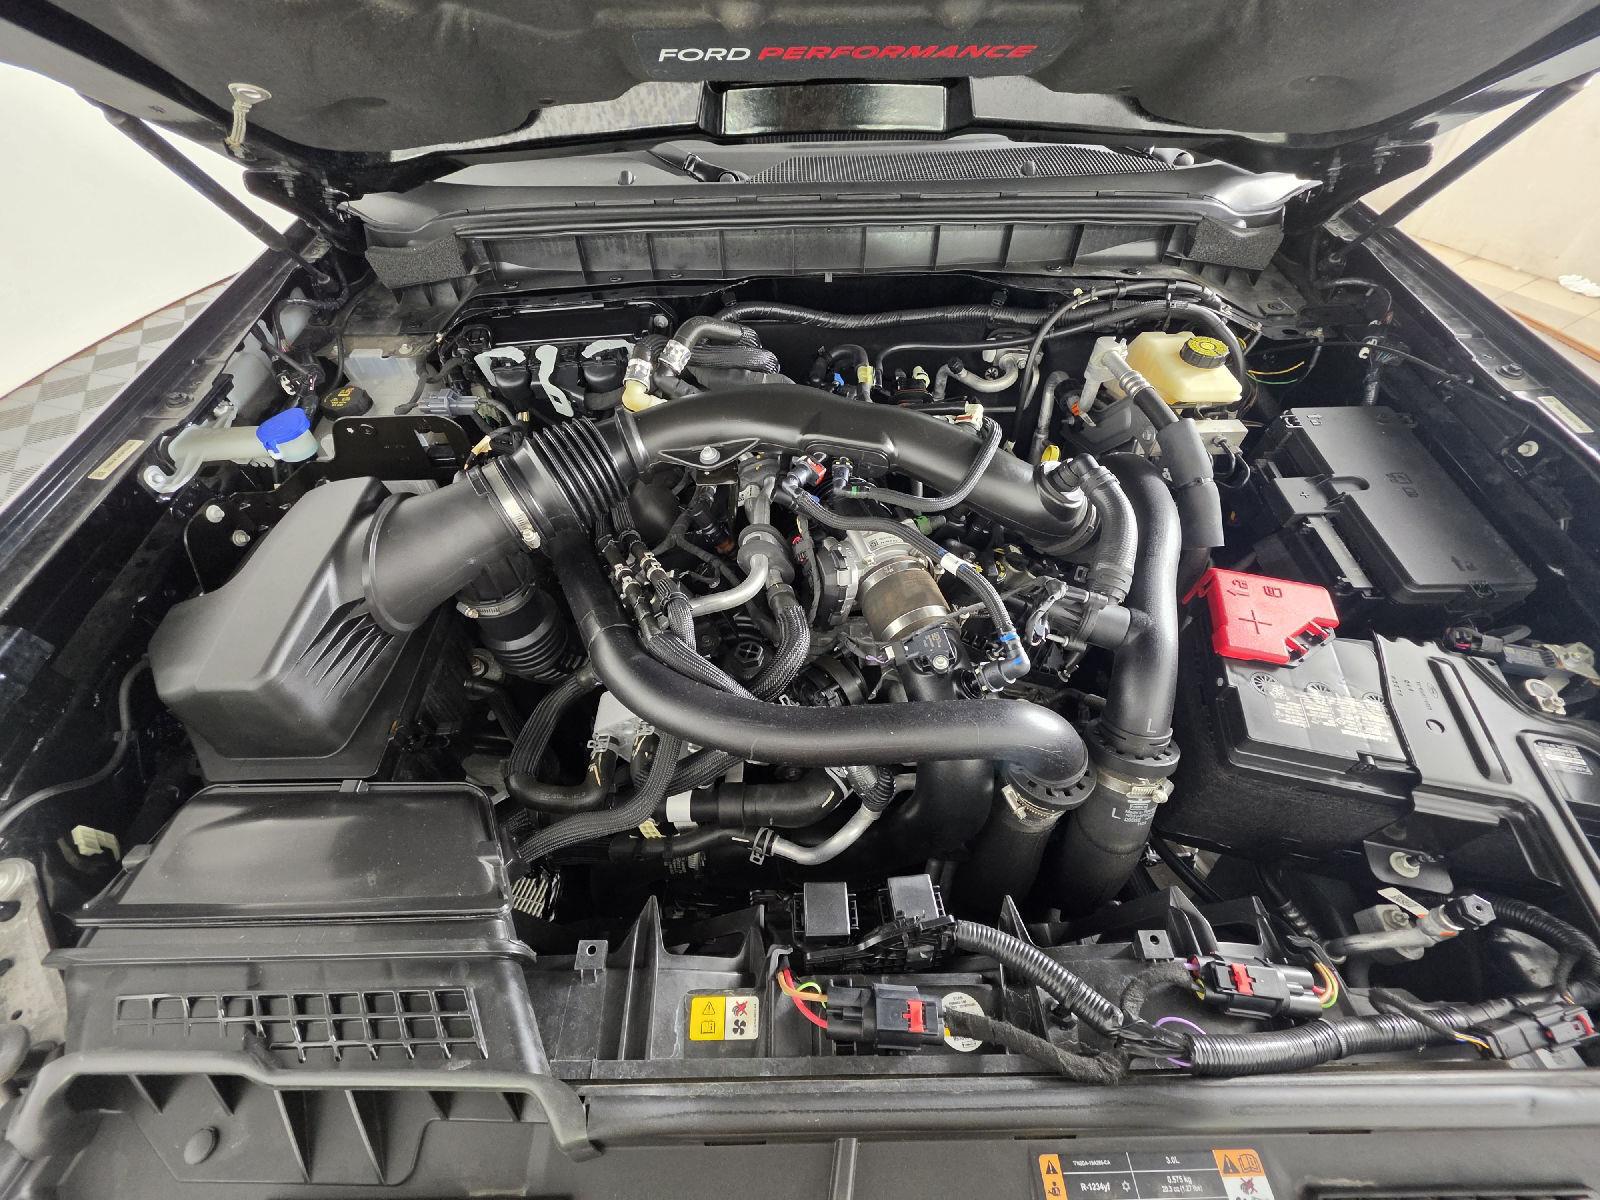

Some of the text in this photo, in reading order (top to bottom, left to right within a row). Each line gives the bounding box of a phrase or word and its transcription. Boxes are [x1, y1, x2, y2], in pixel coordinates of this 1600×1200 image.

[657, 44, 1037, 62] FORD PERFORMANCE
[1165, 1155, 1180, 1165] 3.0L
[1166, 1175, 1183, 1184] 0.575
[1080, 1181, 1111, 1193] R-1234yf
